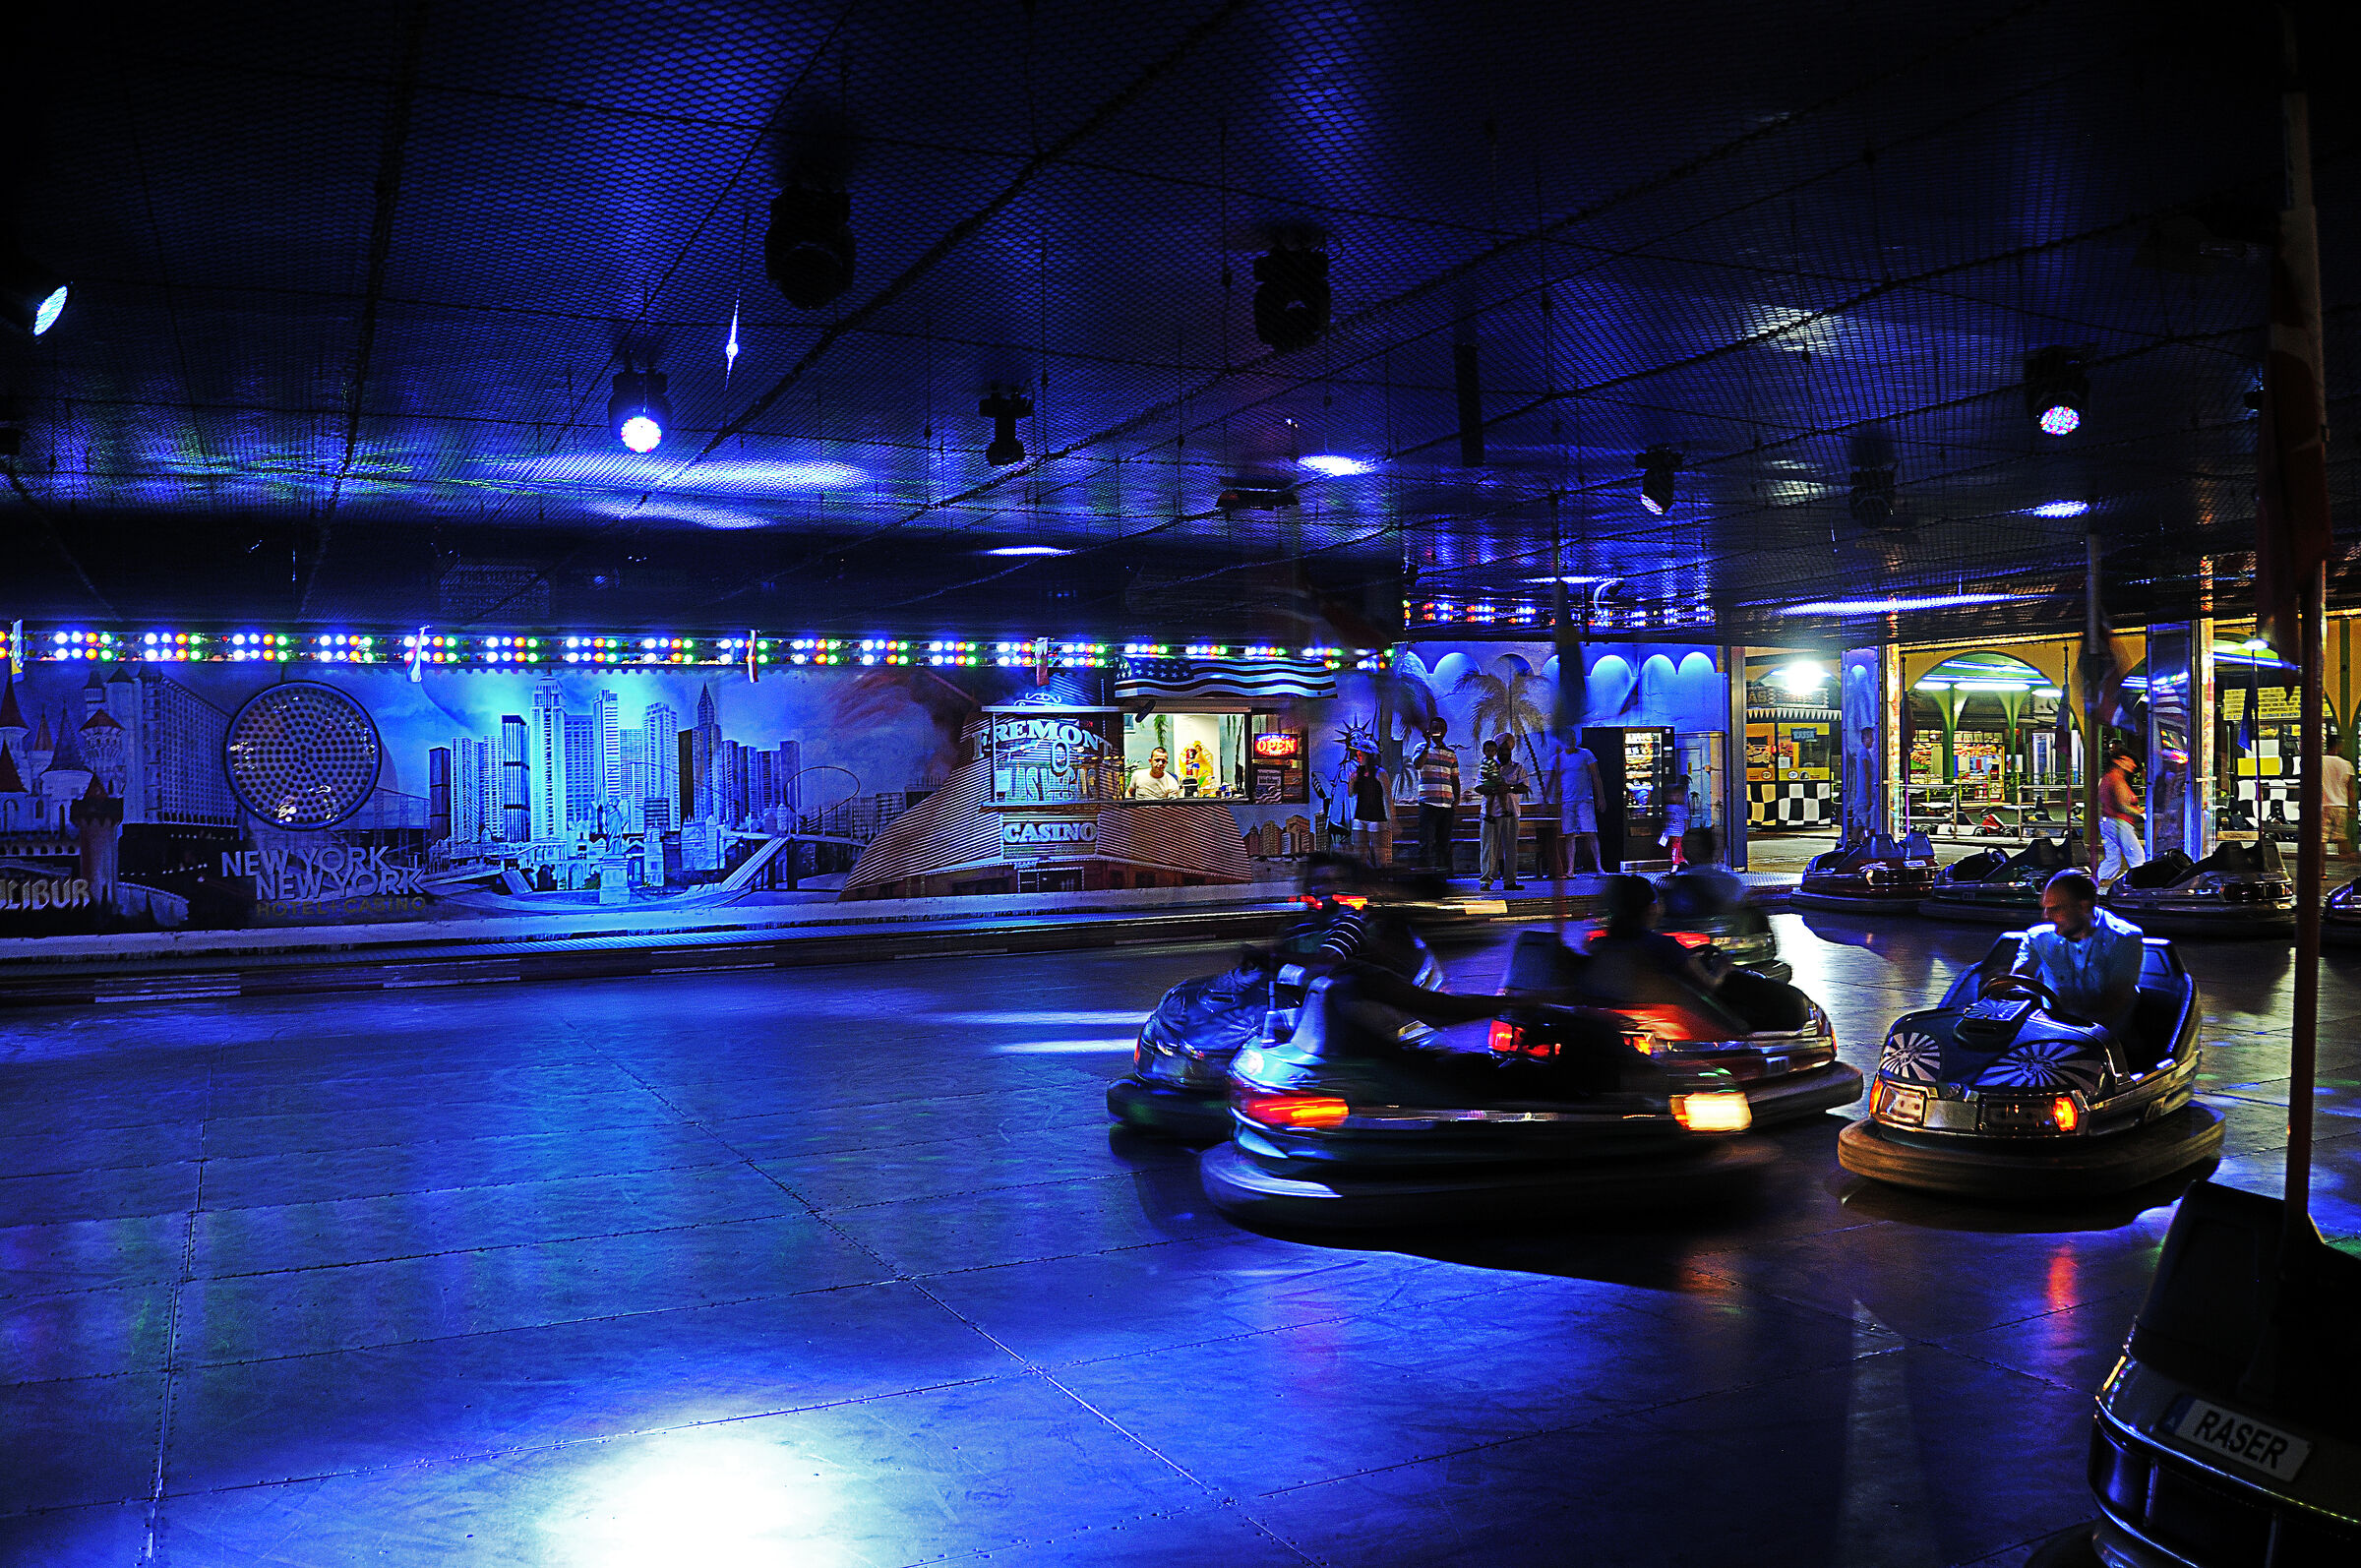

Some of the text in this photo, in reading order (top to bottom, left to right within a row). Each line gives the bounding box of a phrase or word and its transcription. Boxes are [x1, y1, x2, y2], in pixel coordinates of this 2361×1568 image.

[972, 719, 1113, 762] FREMONT
[1256, 738, 1296, 753] OPEN
[1002, 822, 1098, 843] CASINO
[221, 846, 389, 877] NEW YORK
[256, 868, 425, 900] NEW YORK
[2194, 1411, 2287, 1469] RASER
